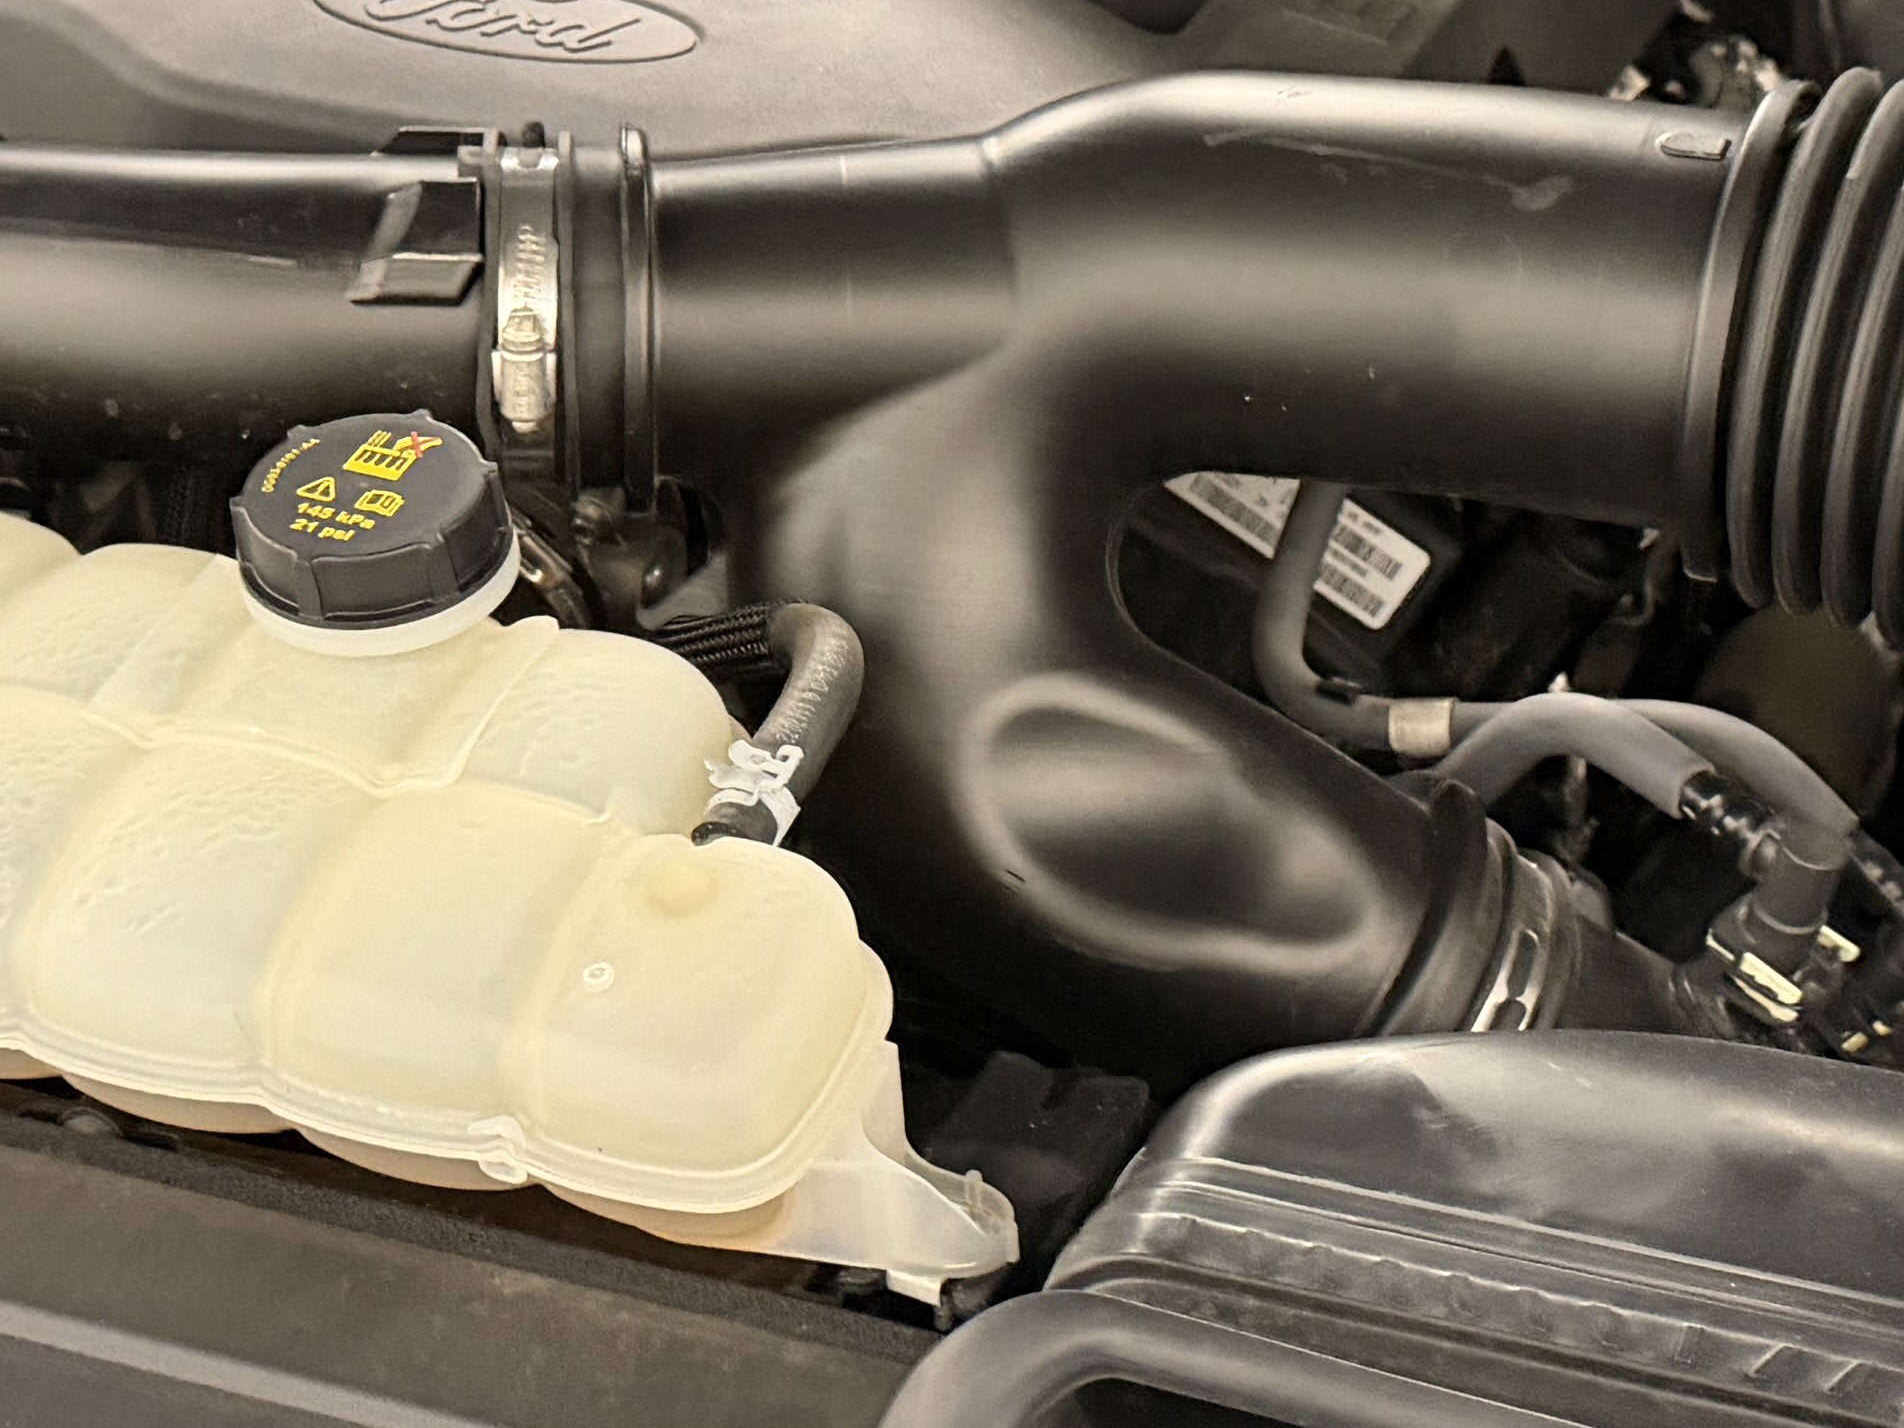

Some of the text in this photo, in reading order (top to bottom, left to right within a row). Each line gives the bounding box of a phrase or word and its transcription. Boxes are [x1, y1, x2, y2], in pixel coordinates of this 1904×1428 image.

[297, 503, 376, 529] 145 kPa
[289, 518, 355, 541] 21 psi
